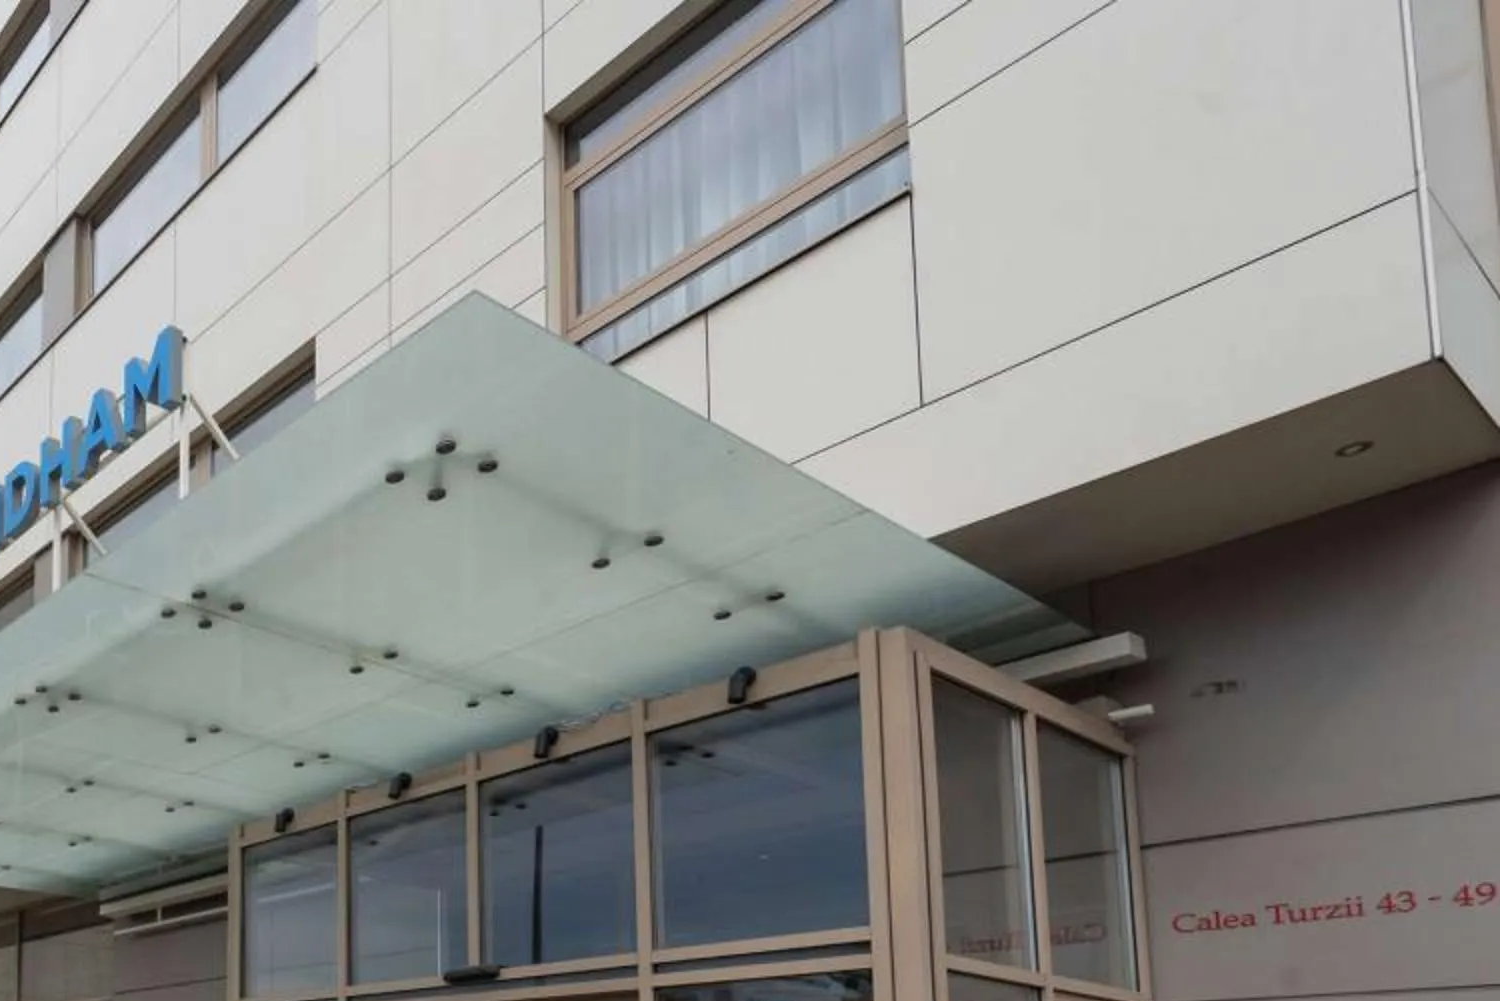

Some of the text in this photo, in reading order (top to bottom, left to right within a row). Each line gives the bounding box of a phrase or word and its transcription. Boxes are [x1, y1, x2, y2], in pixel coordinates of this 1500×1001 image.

[1171, 910, 1257, 933] Calea
[1265, 896, 1364, 925] Turzii
[1376, 890, 1418, 914] 43
[1453, 881, 1498, 908] 49
